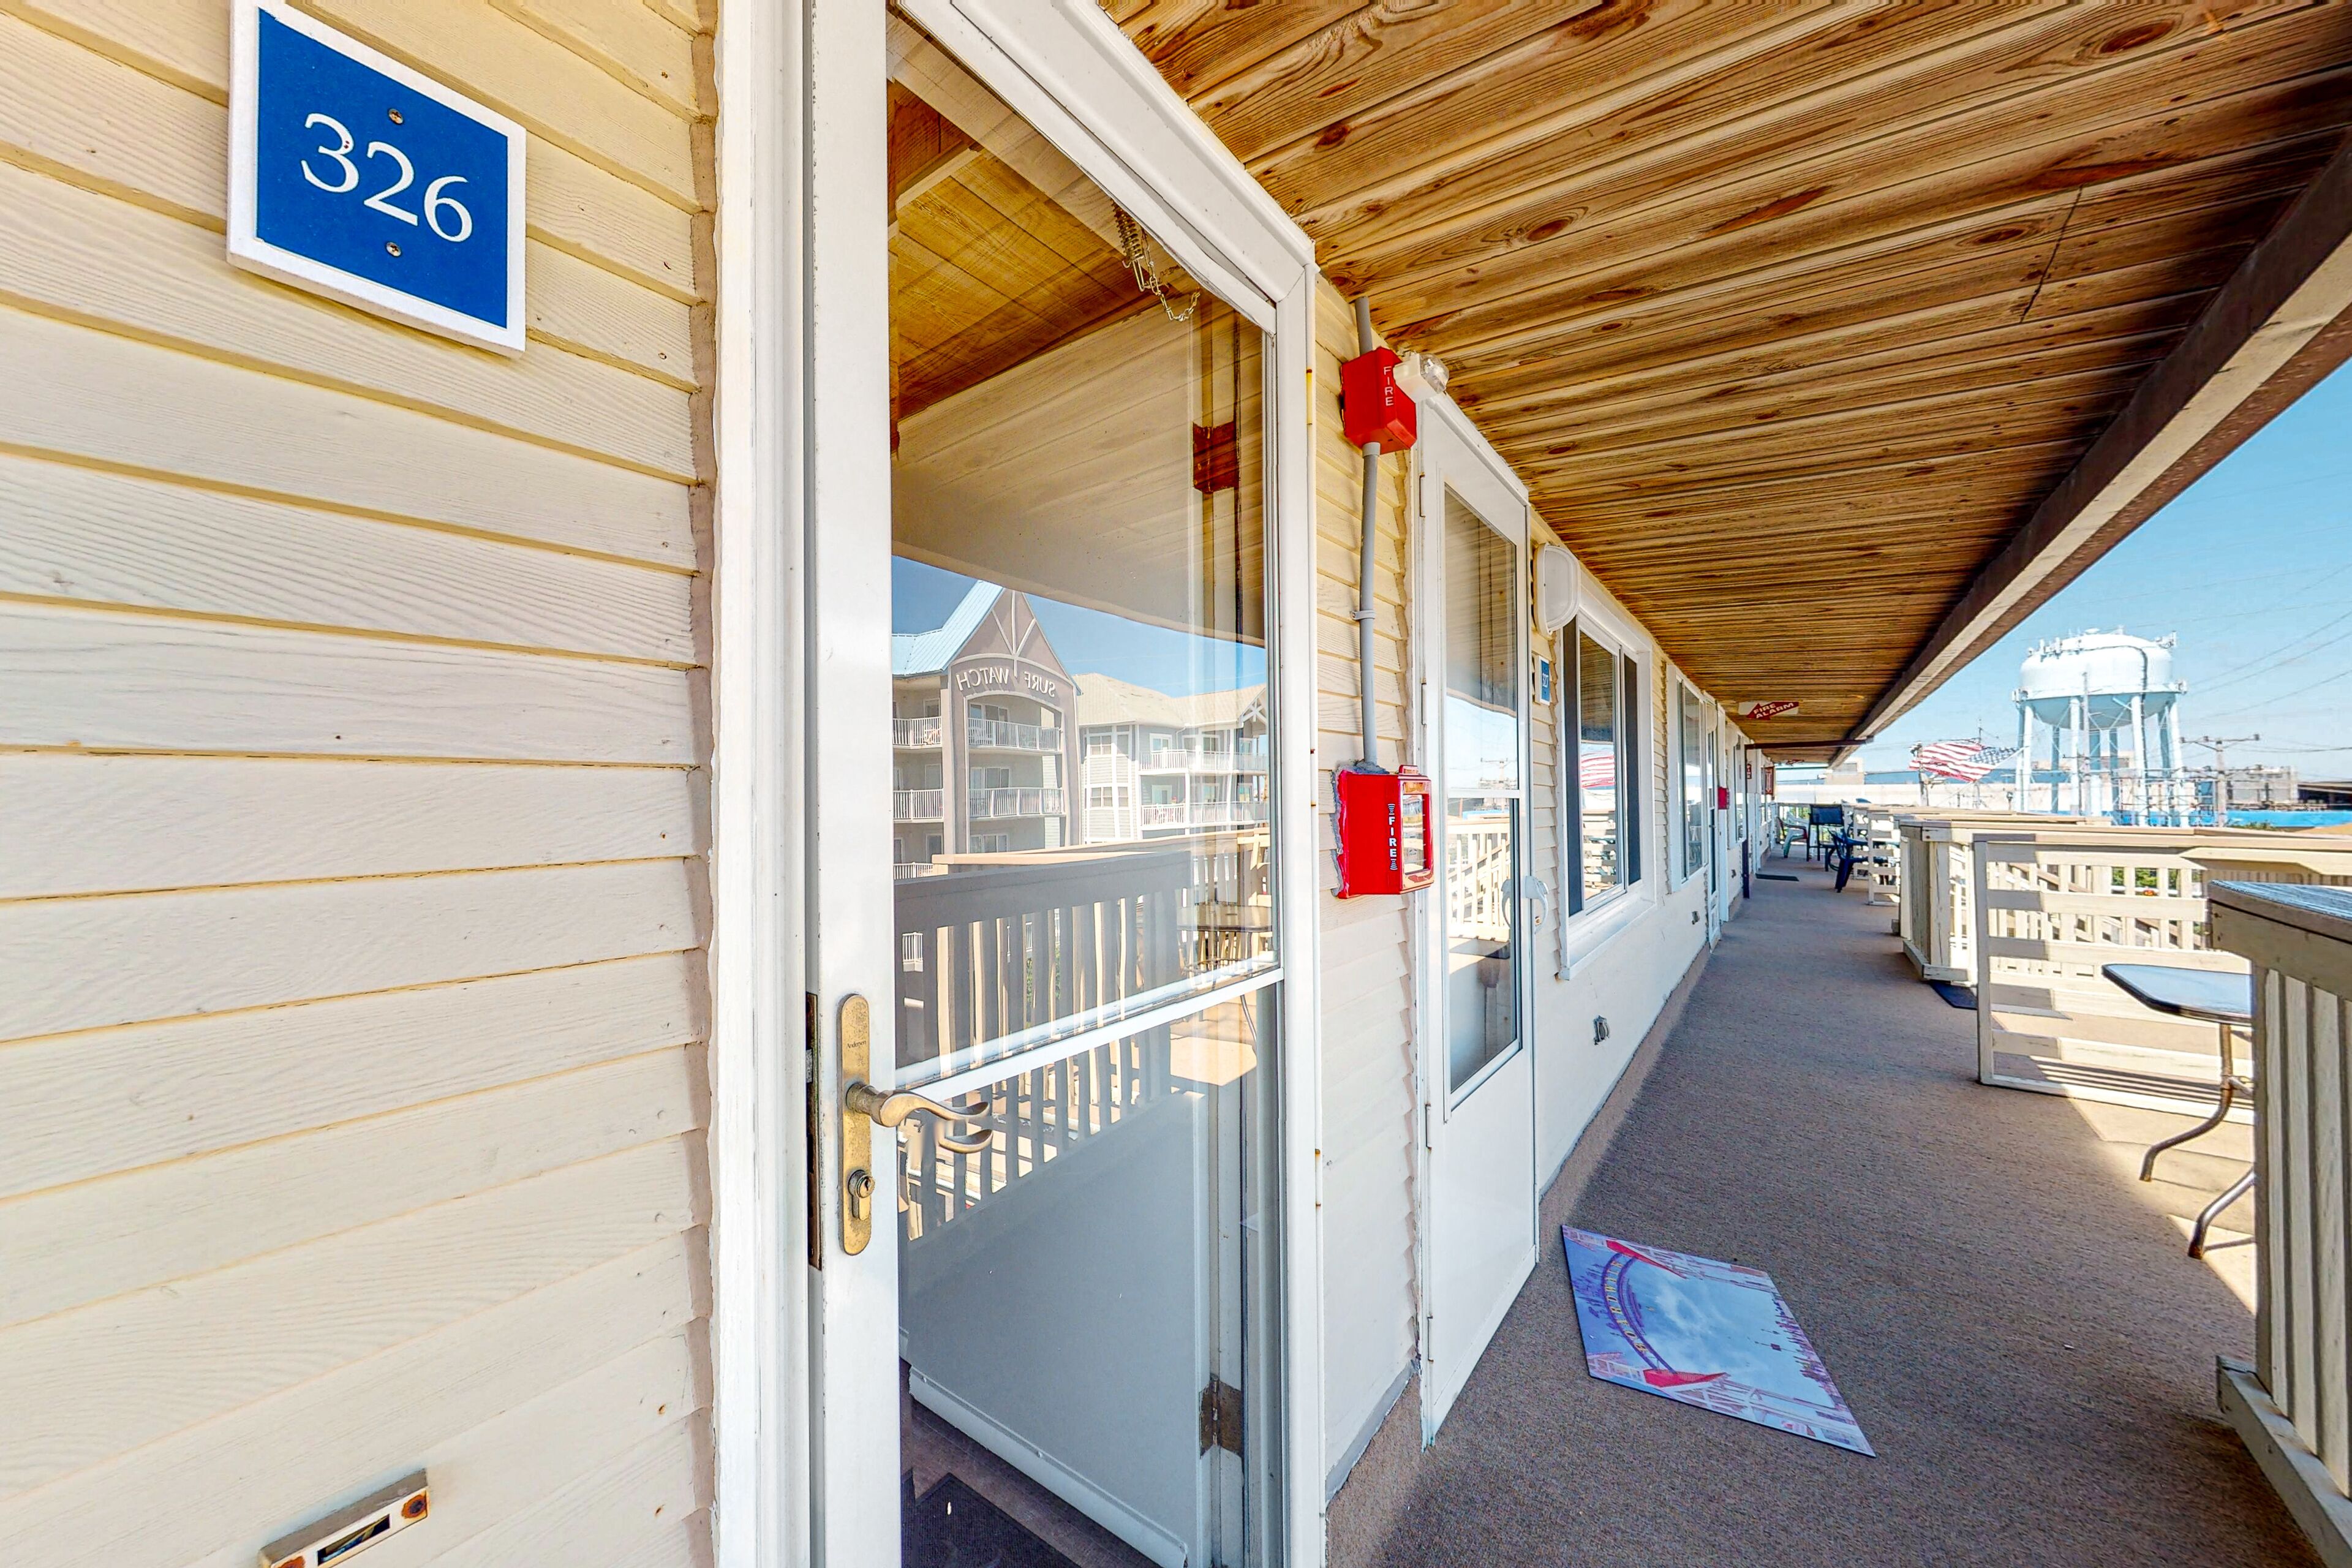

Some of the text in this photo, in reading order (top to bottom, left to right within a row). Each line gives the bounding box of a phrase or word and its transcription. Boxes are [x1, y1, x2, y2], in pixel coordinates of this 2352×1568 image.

[300, 113, 473, 243] 326
[1384, 366, 1393, 406] FIRE
[1754, 704, 1776, 714] FIRE
[1756, 703, 1794, 718] ALARM
